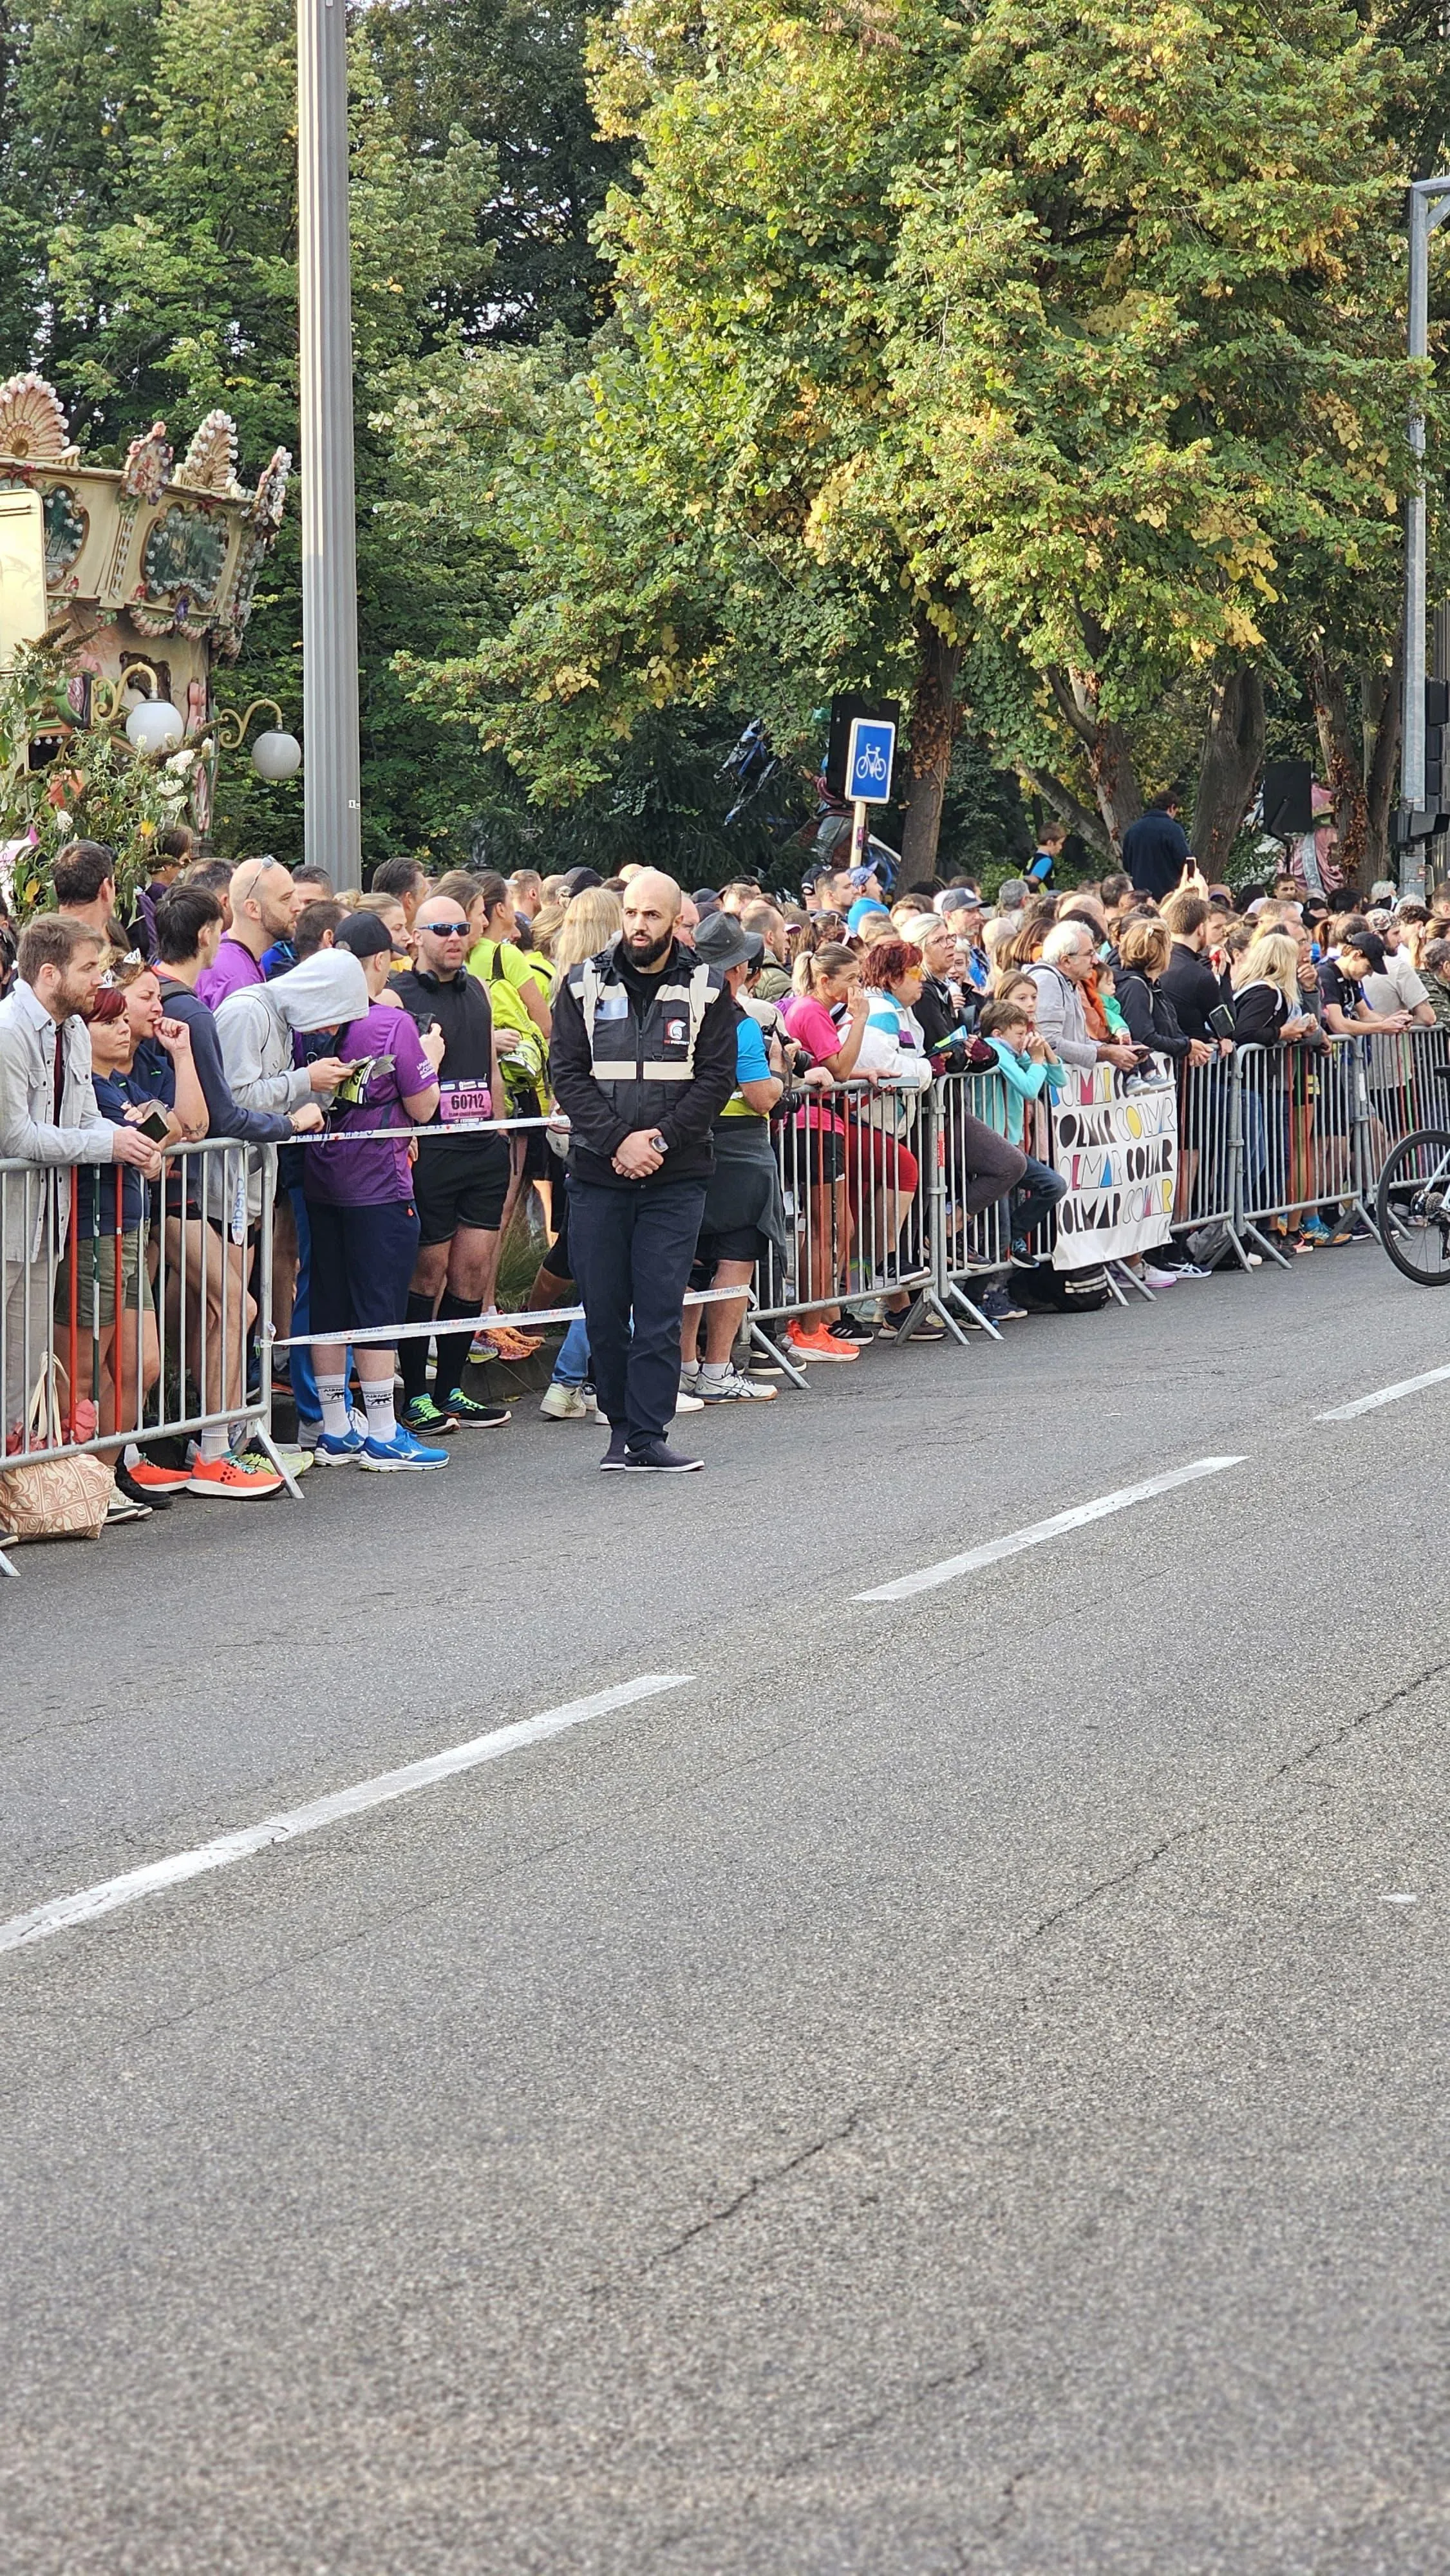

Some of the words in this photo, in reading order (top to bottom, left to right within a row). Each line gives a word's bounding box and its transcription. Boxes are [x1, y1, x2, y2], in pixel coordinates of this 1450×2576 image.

[451, 1094, 485, 1110] 60712
[1059, 1150, 1124, 1191] OLMAR
[1122, 1178, 1173, 1224] COMAR
